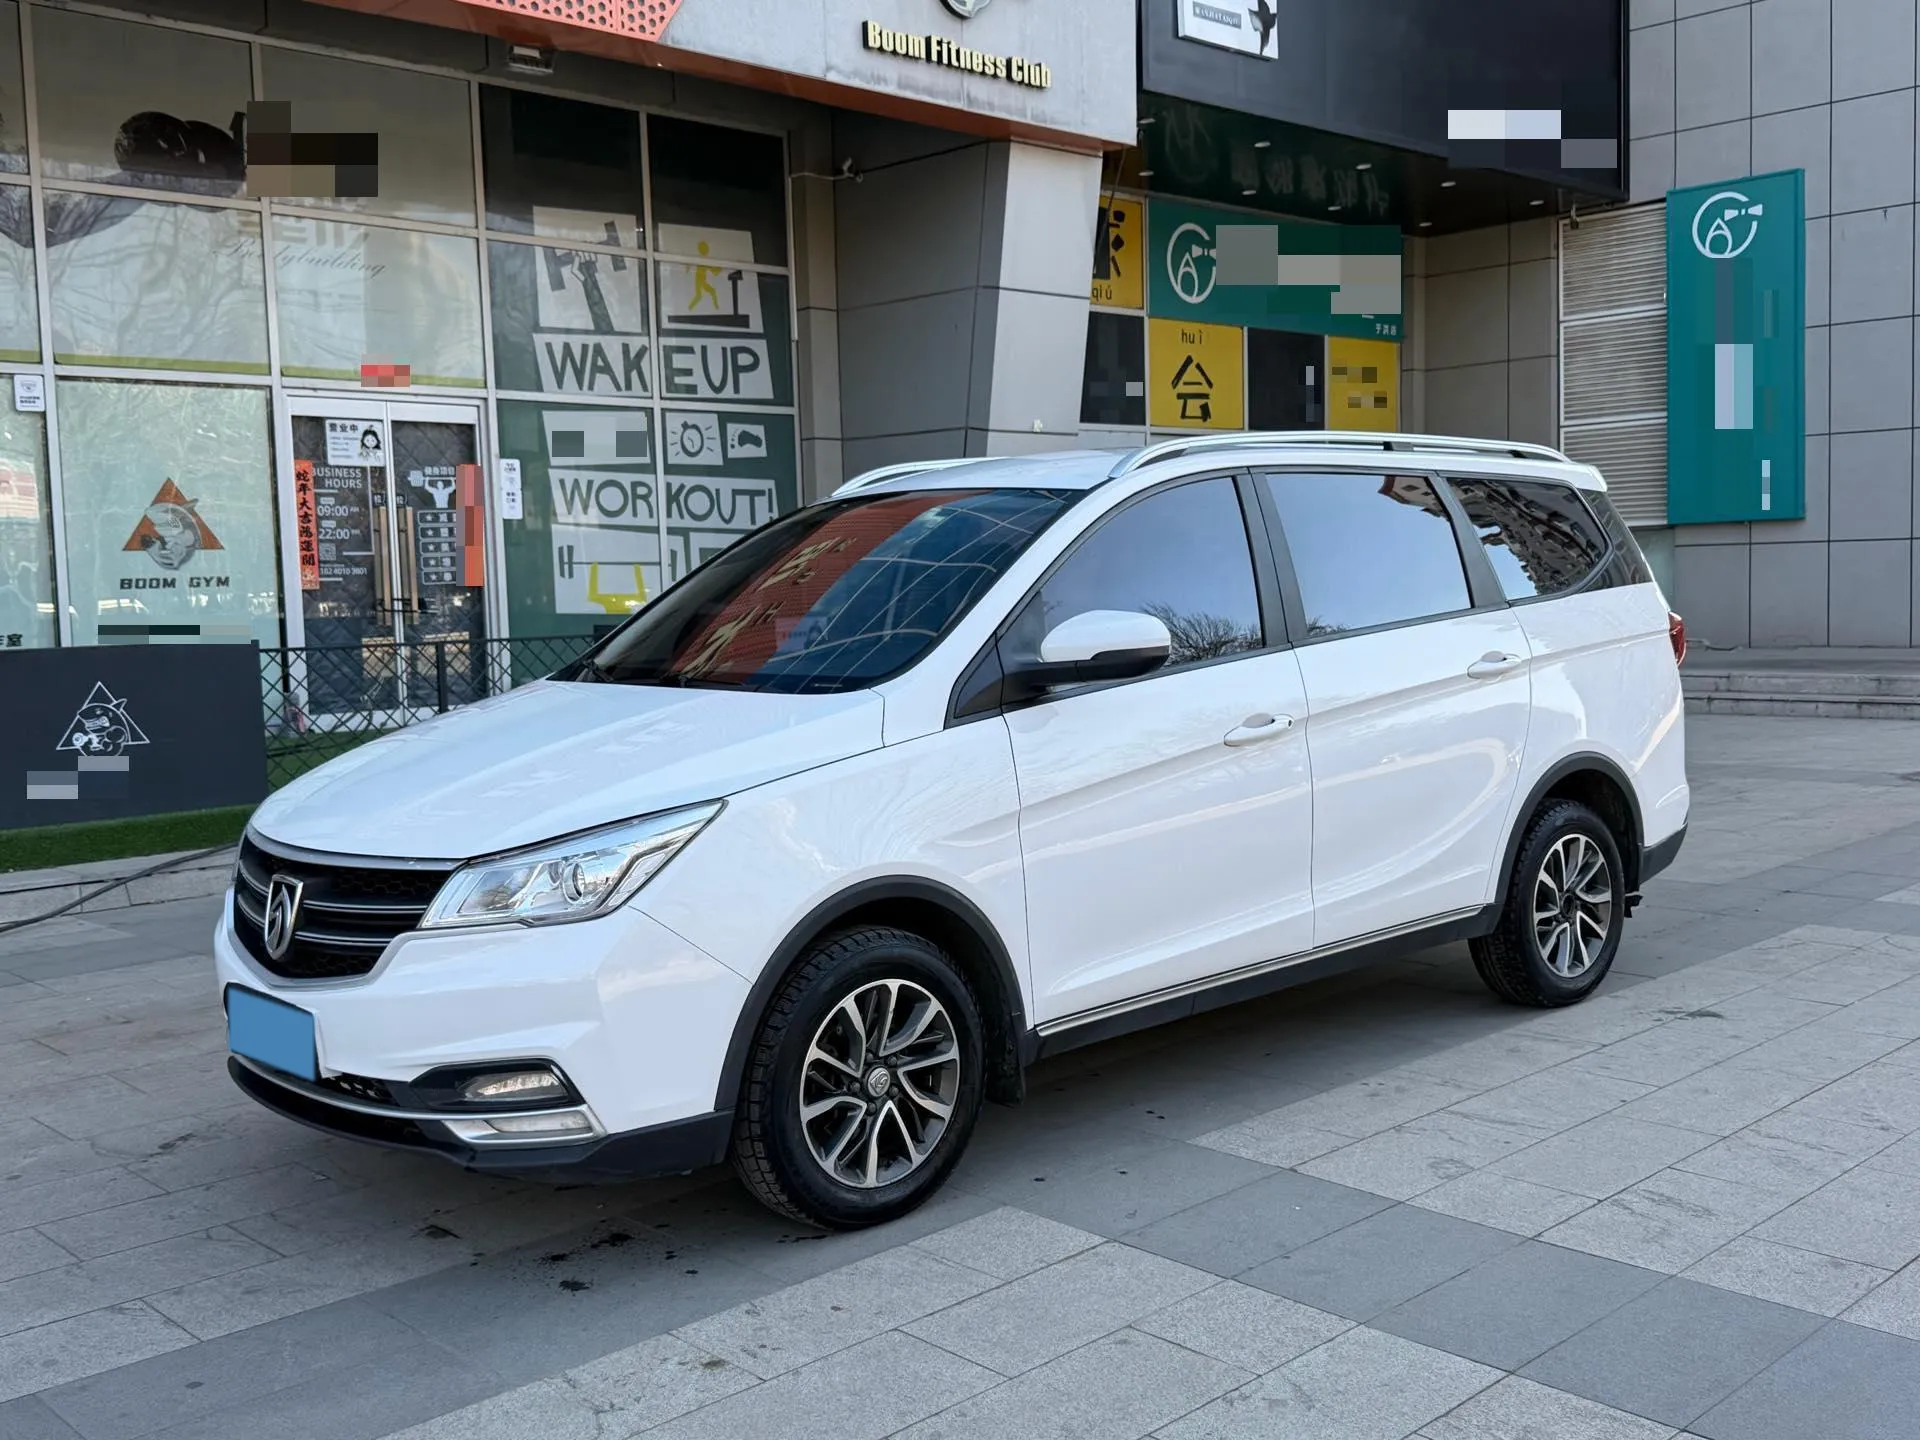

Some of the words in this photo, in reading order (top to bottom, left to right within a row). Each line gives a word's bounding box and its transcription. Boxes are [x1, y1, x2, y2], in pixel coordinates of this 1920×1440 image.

[863, 20, 926, 59] Boom
[929, 35, 1007, 79] Fitness
[1009, 56, 1052, 88] Club
[1171, 355, 1213, 422] 会
[329, 422, 358, 433] 营业中
[312, 467, 361, 478] BUSINESS
[325, 479, 362, 489] HOURS
[317, 505, 348, 517] 09:00
[319, 528, 350, 540] 22:00
[119, 578, 177, 590] BOOM
[188, 576, 230, 588] GYM
